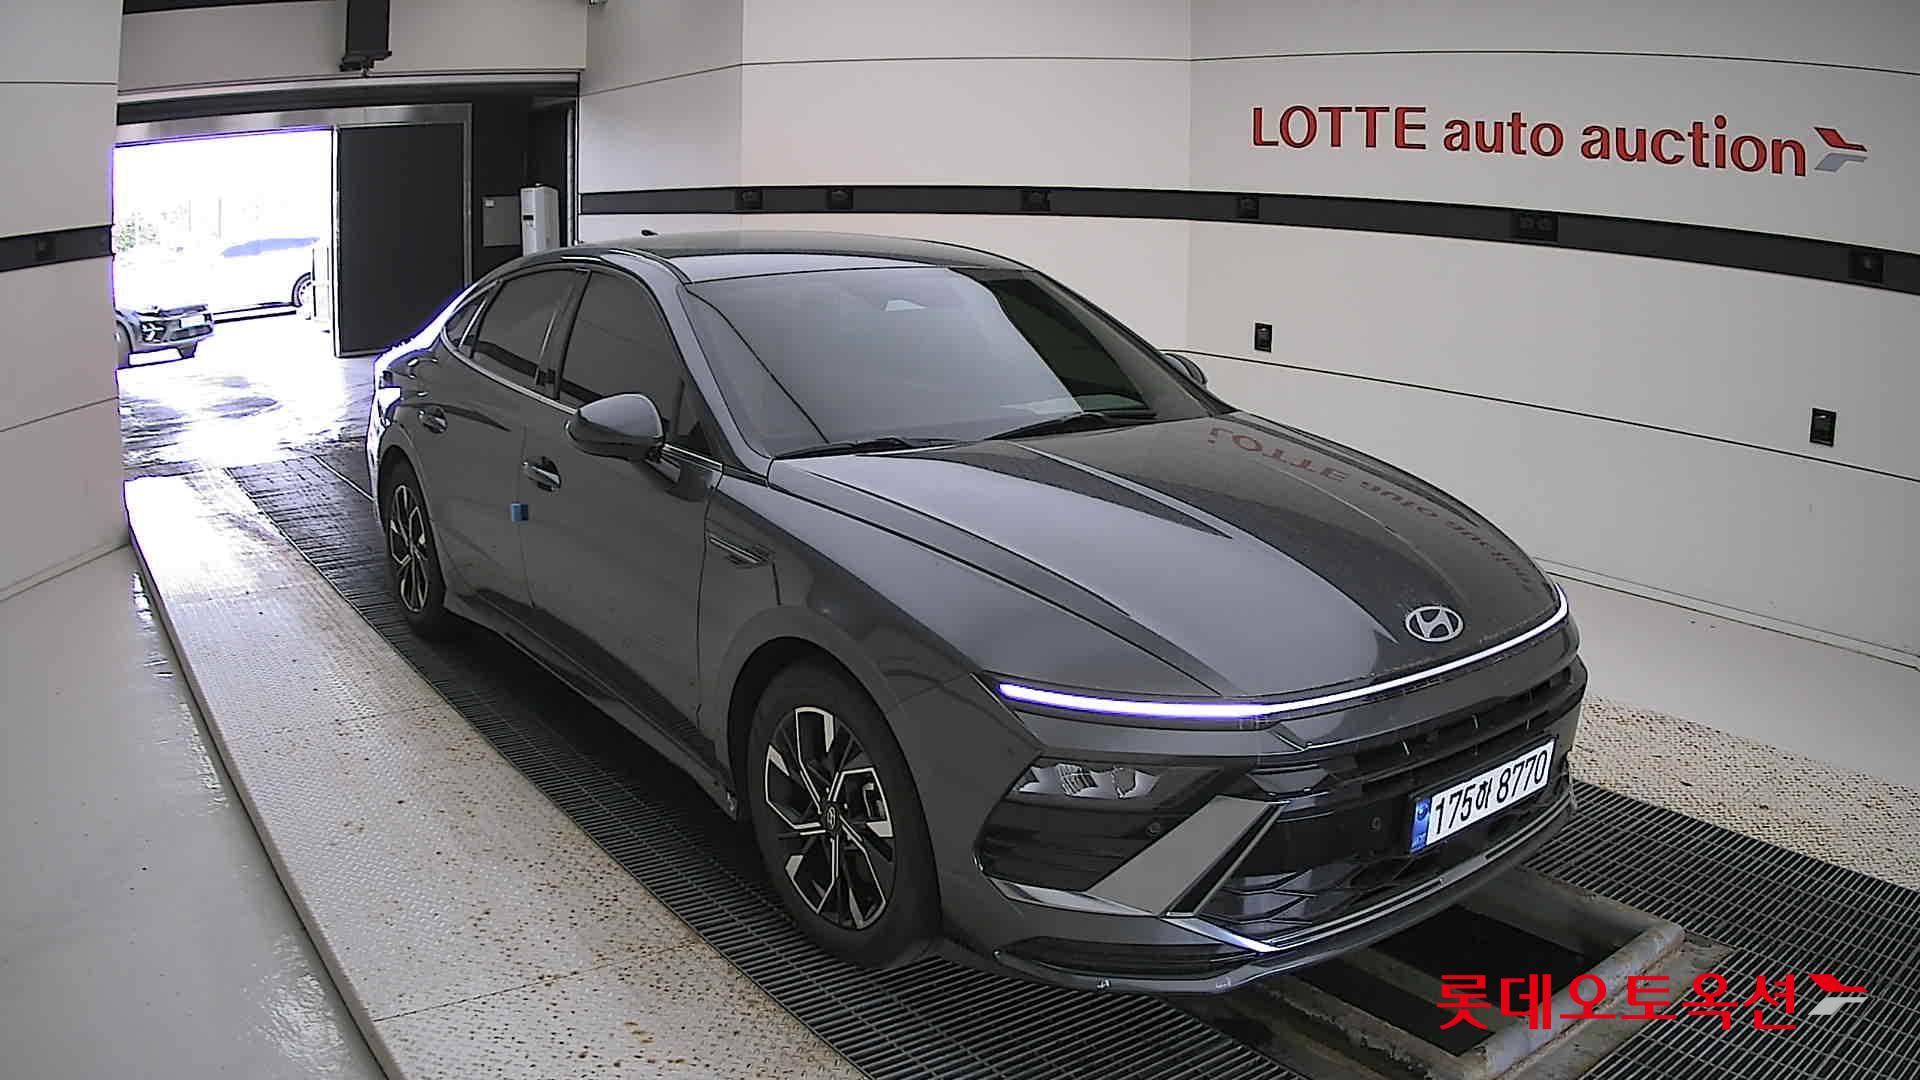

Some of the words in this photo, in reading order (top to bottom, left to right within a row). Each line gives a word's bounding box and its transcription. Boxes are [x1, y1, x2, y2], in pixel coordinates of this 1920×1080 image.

[1253, 105, 1425, 149] LOTTE
[1443, 112, 1565, 162] auto
[1579, 115, 1807, 177] auction
[1496, 750, 1547, 804] 8770
